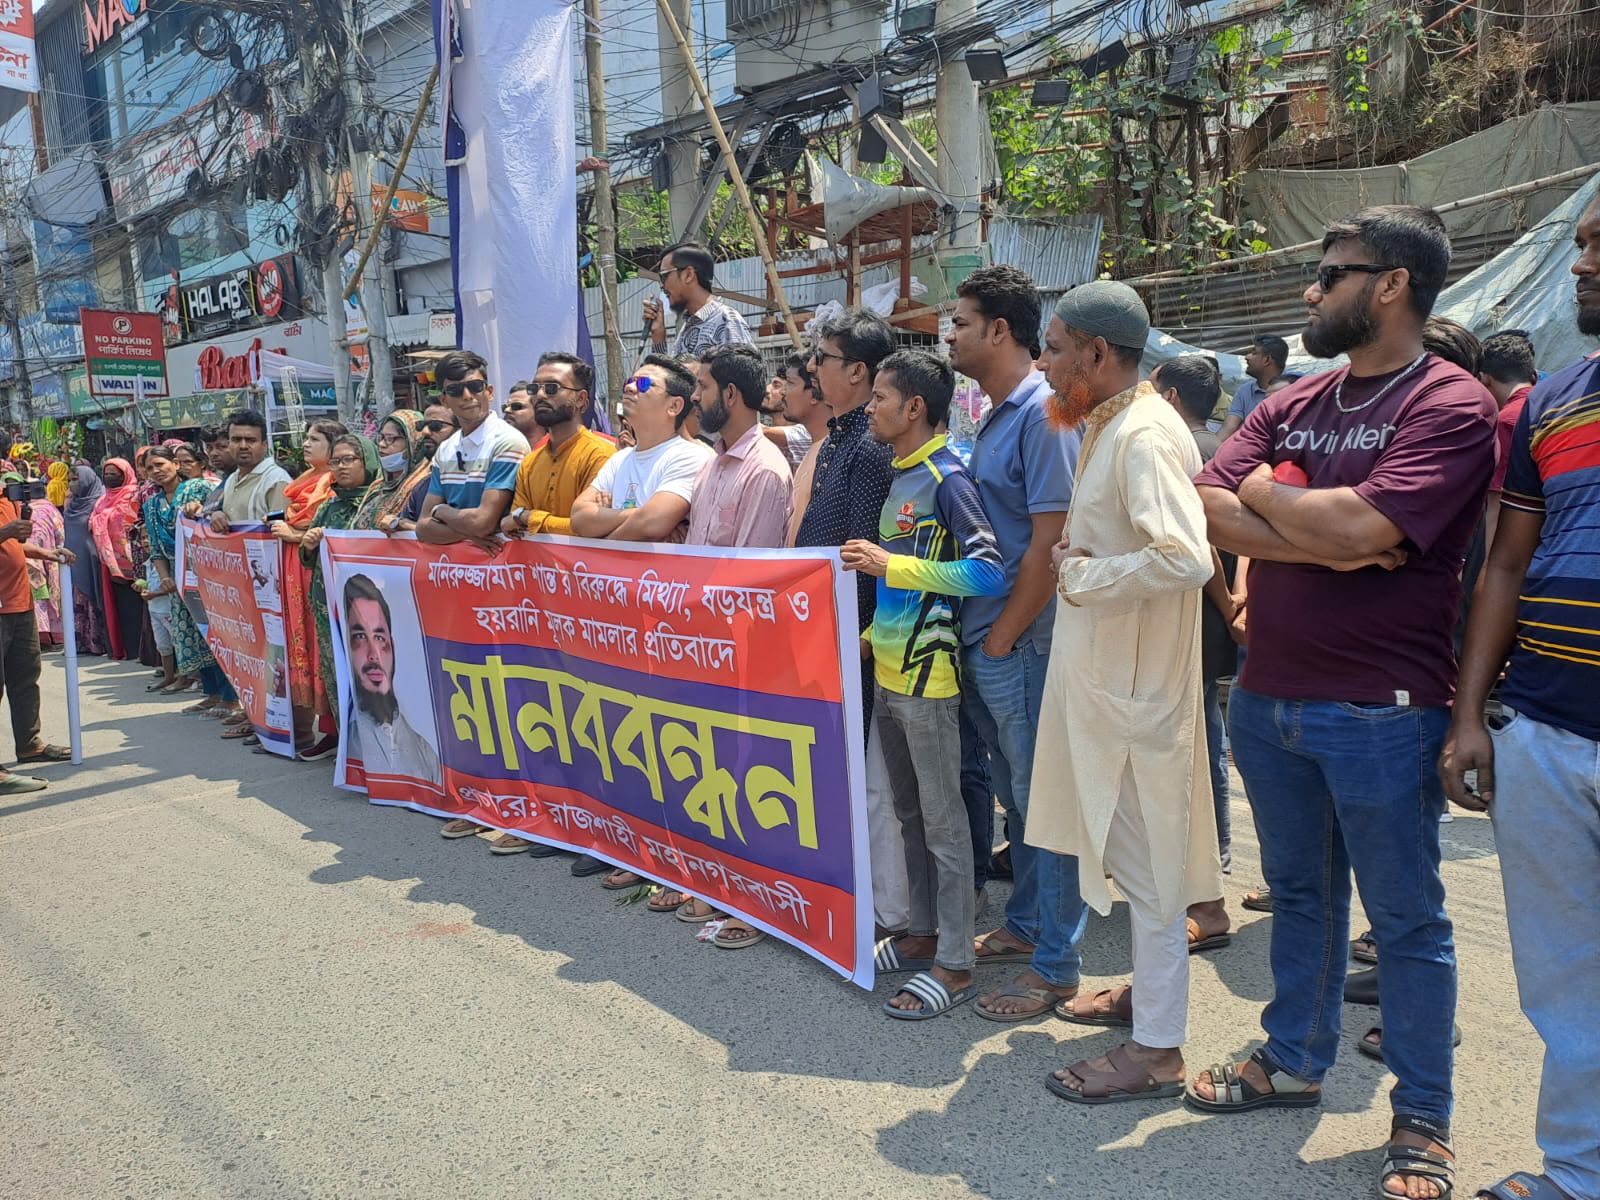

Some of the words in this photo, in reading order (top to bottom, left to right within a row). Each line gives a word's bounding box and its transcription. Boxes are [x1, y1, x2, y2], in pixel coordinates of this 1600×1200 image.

[187, 279, 241, 319] HALAB
[94, 335, 109, 344] NO
[111, 336, 152, 346] PARKING
[198, 337, 288, 390] Bat
[100, 380, 157, 390] WALTN
[428, 553, 526, 592] মনিরুজ্জামান
[572, 561, 633, 607] বিরুদ্ধে
[786, 591, 809, 622] ও
[472, 598, 540, 635] হয়রানি
[543, 609, 576, 648] মূলক
[578, 617, 638, 657] মামলার
[643, 621, 737, 673] প্রতিবাদে
[441, 655, 819, 850] মানববন্ধন
[544, 803, 638, 856] রাজশাহী
[643, 835, 812, 929] মহানগরবাসী
